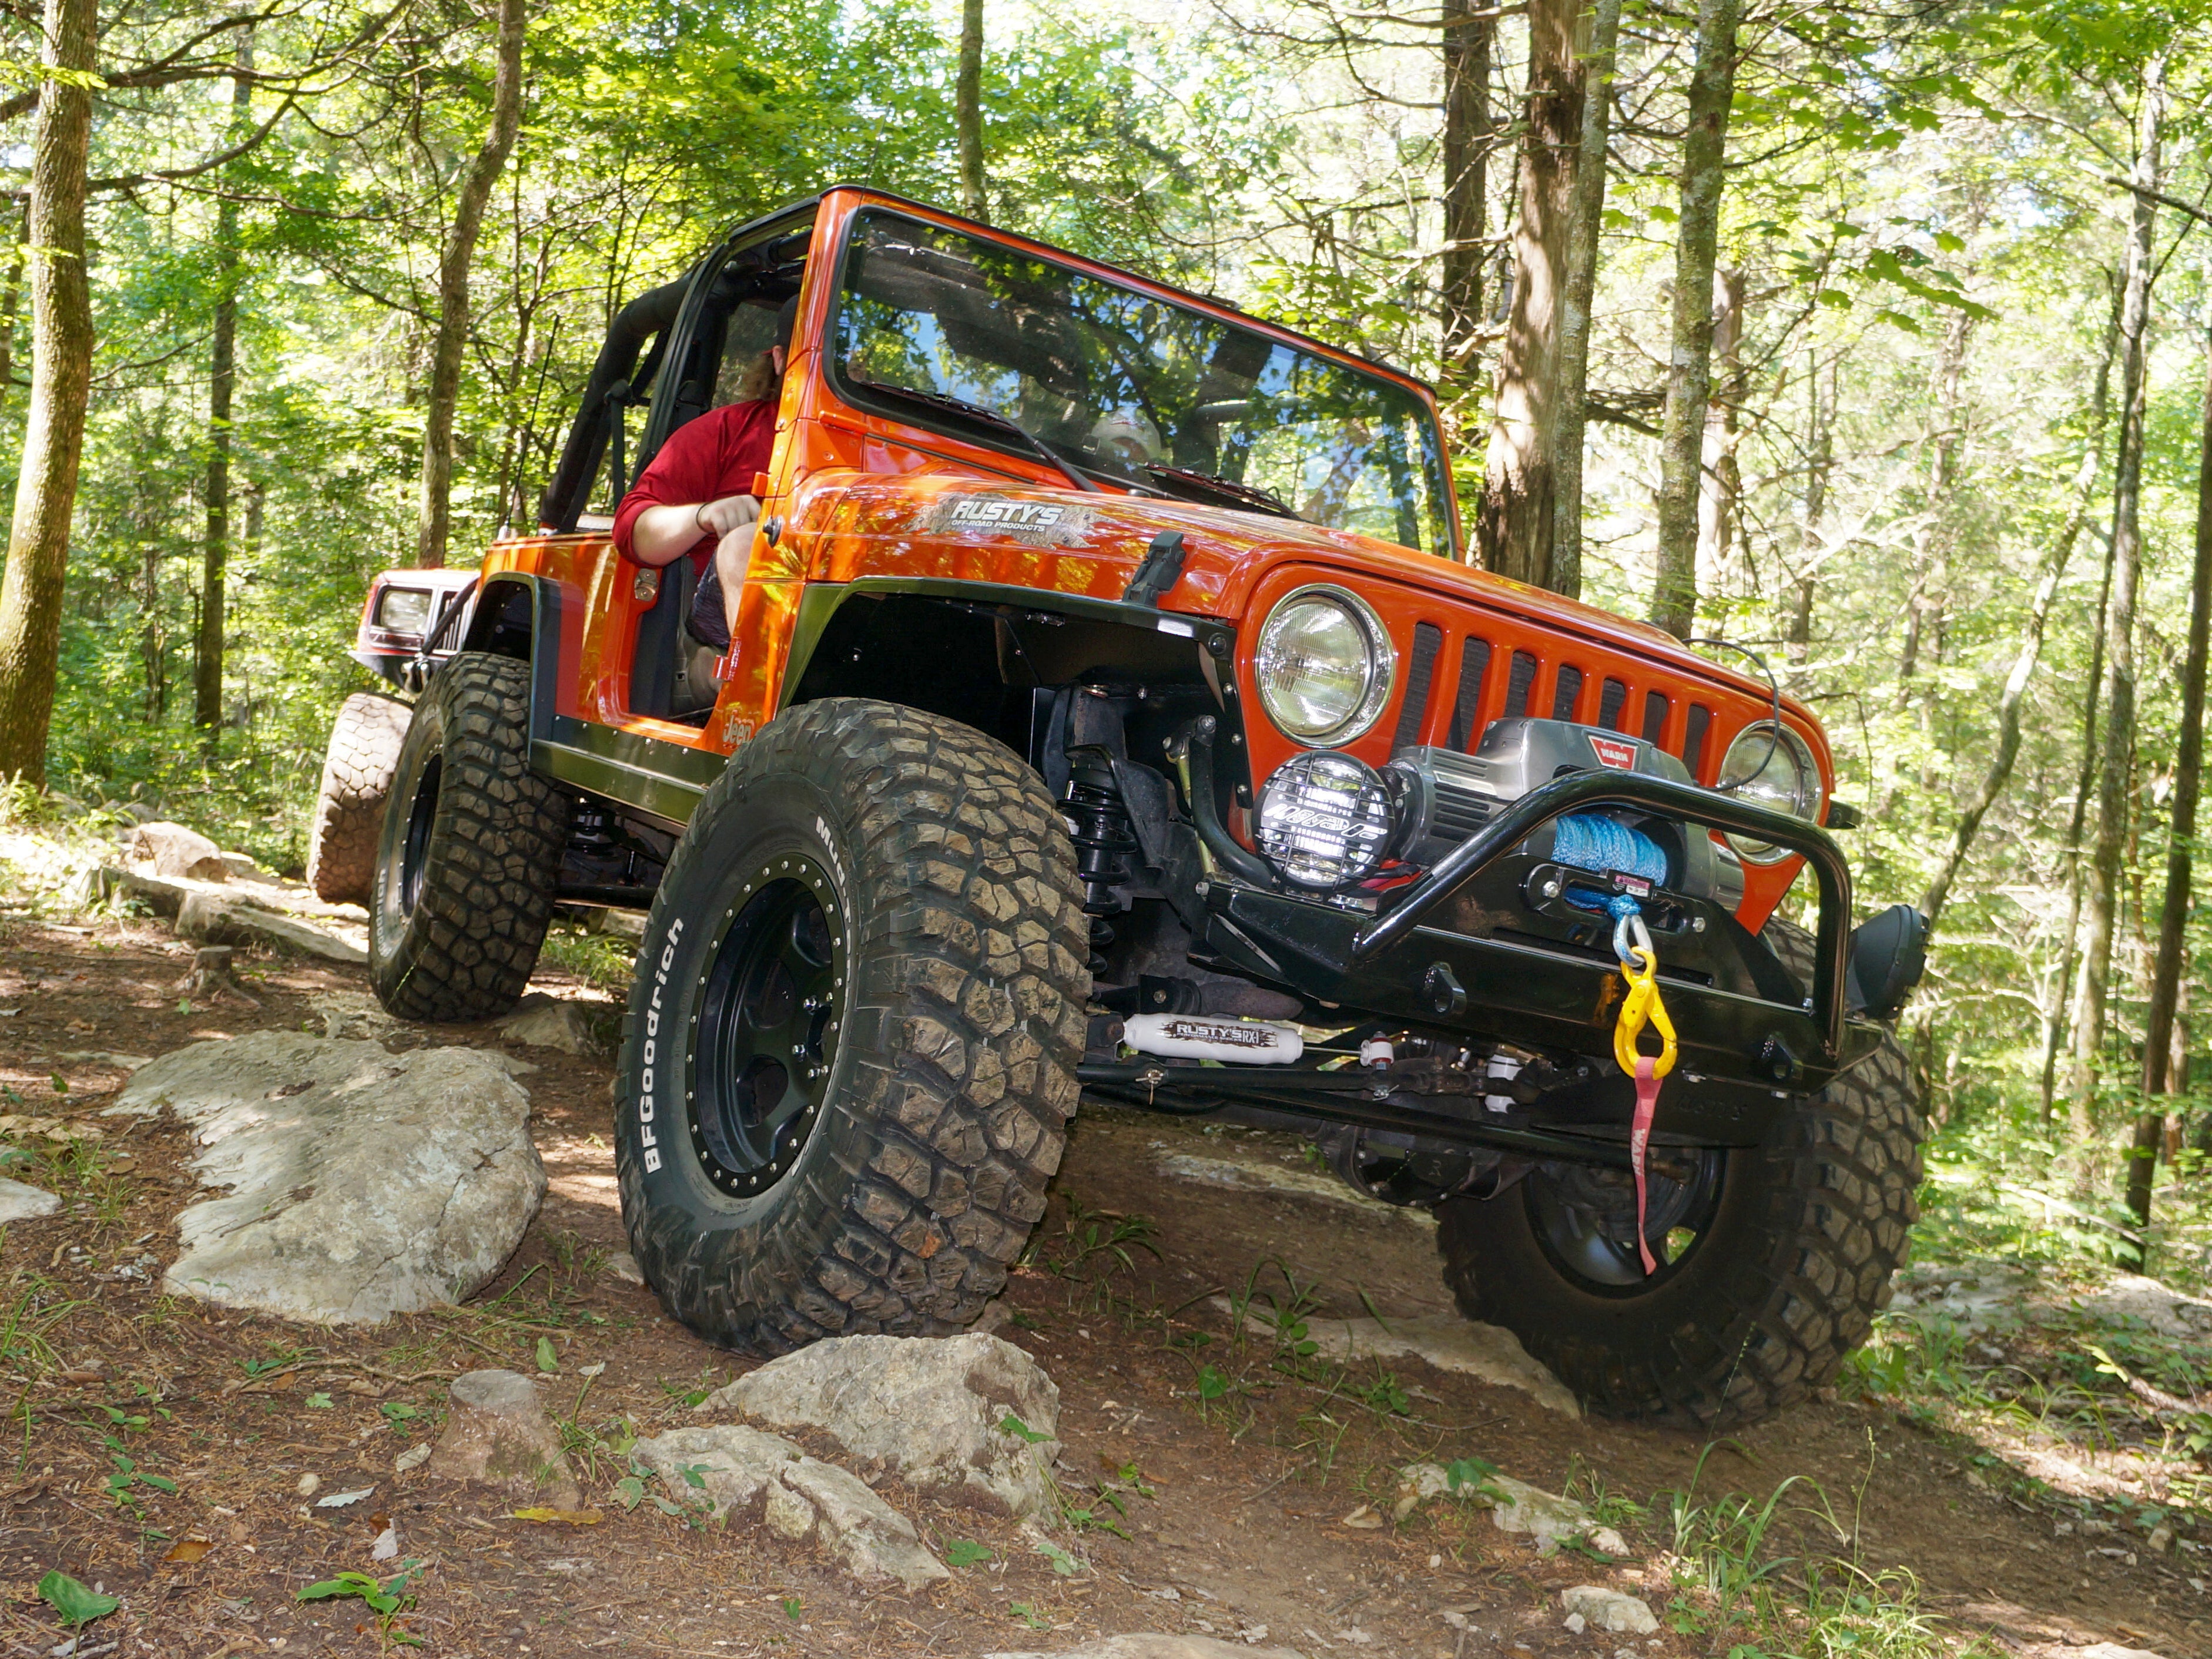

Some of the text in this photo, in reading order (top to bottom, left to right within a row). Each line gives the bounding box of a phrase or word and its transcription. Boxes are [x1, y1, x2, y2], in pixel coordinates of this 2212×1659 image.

[950, 501, 1064, 525] RUSTY'S
[994, 522, 1045, 532] PRODUCTS
[1600, 748, 1628, 762] WARN
[1177, 1024, 1242, 1038] RUSTY'S
[639, 917, 684, 1174] BFGoodrich
